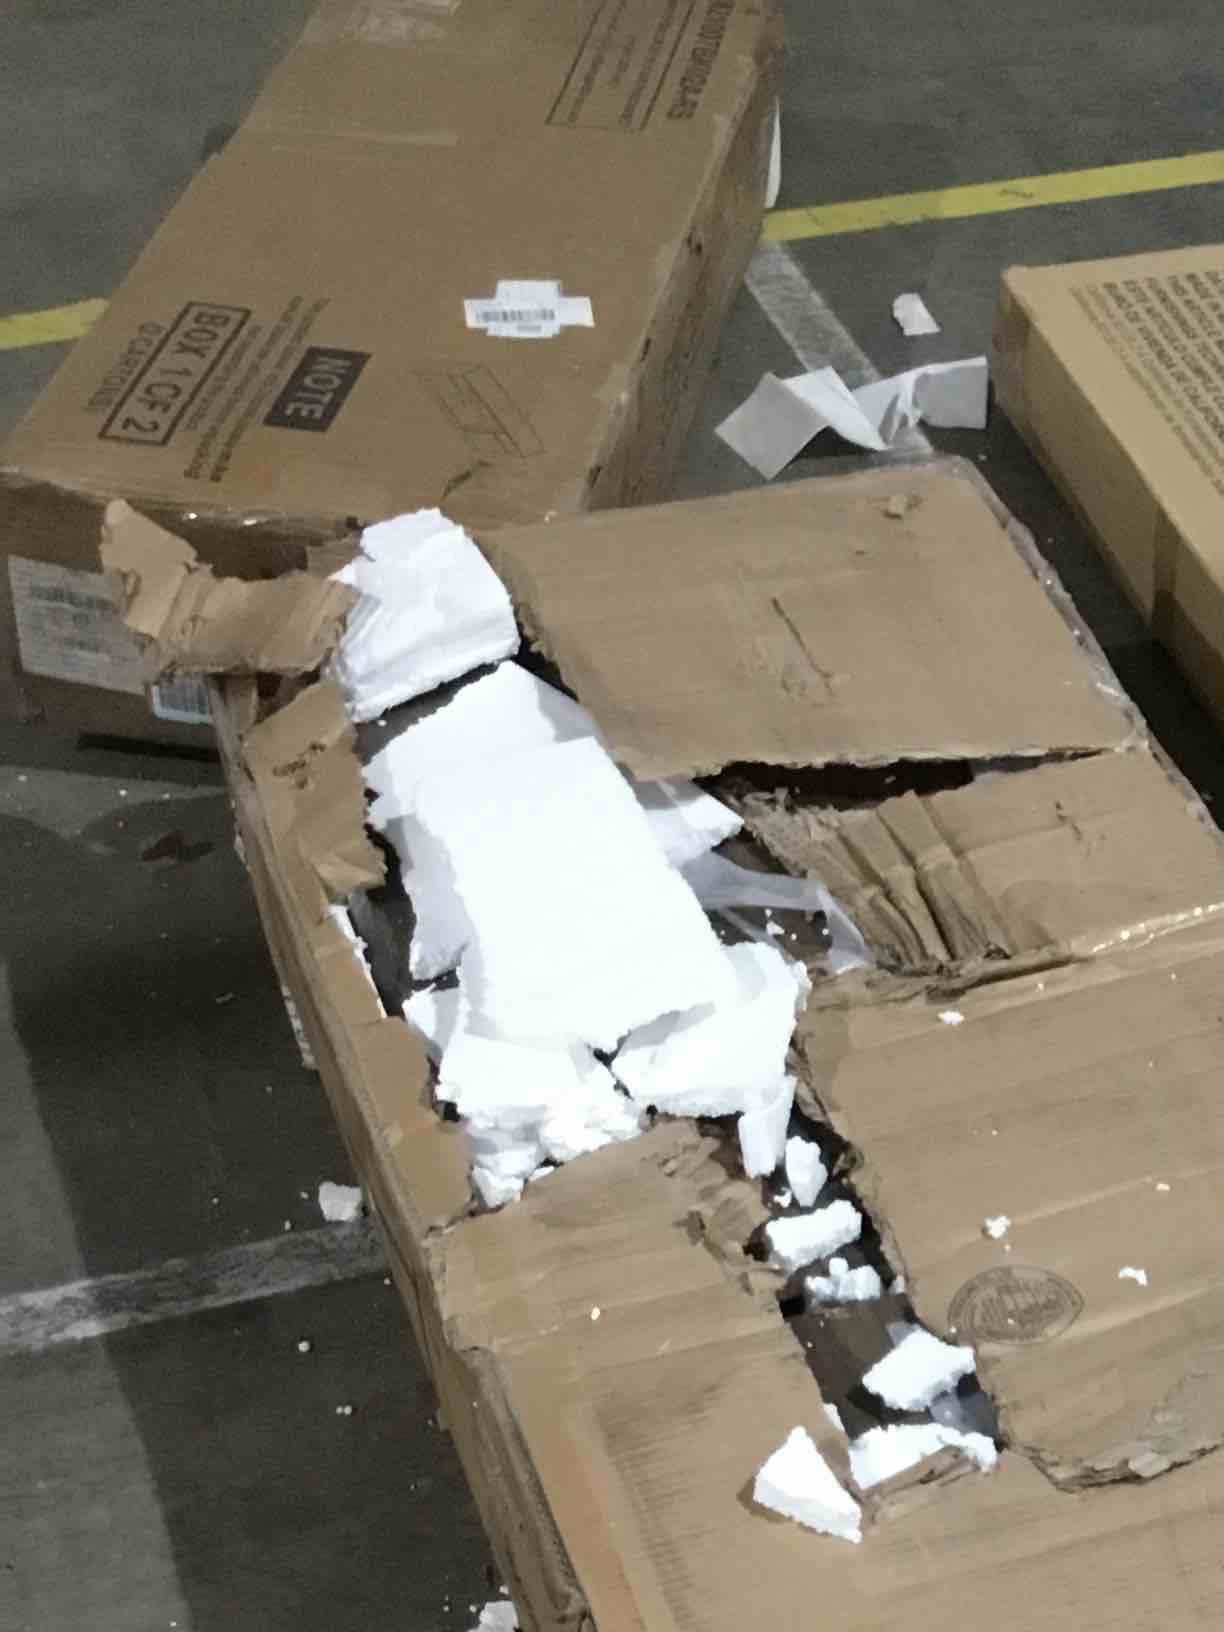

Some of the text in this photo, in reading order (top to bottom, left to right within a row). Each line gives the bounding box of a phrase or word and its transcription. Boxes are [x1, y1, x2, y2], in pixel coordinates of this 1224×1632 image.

[172, 311, 230, 362] BOX
[286, 355, 353, 420] NOTE
[121, 416, 159, 434] 2
